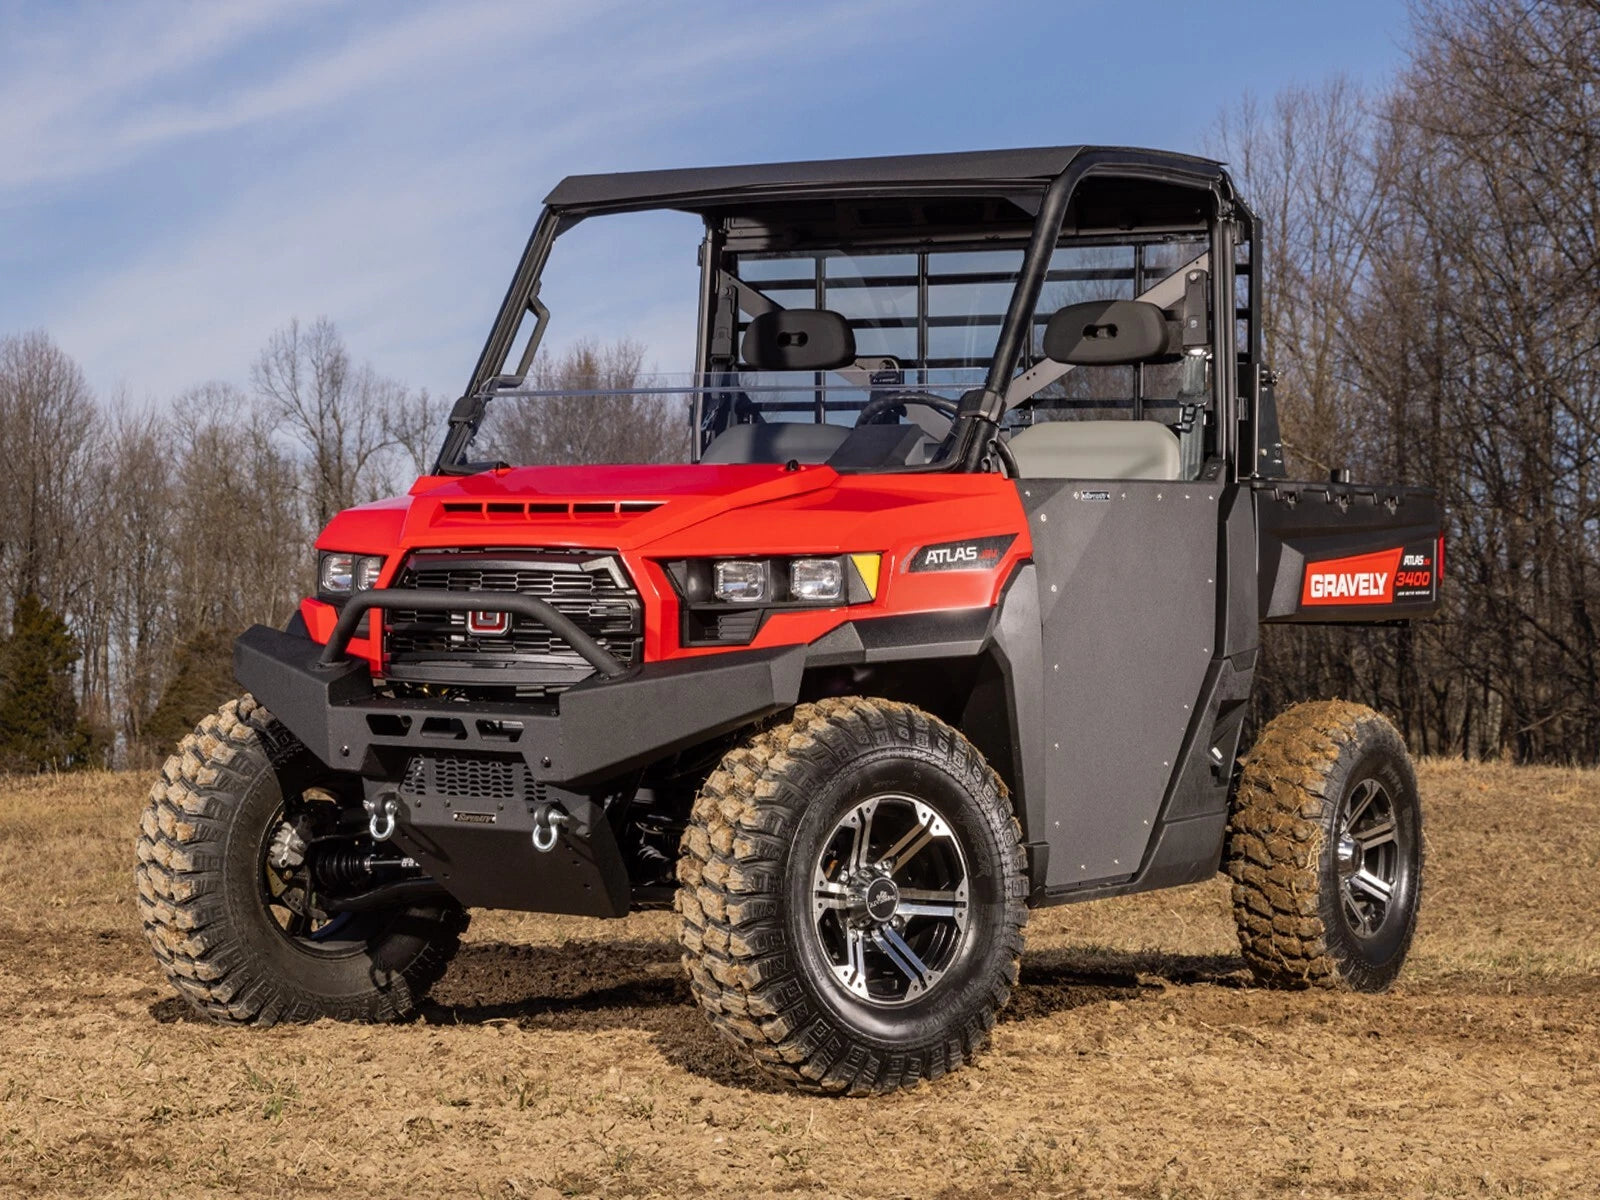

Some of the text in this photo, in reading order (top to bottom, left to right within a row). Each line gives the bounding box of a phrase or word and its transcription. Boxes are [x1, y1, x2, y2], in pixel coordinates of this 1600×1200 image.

[925, 546, 977, 565] ATLAS
[1403, 554, 1424, 566] ATLAS
[1310, 572, 1388, 598] GRAVELY
[1395, 571, 1431, 586] 3400
